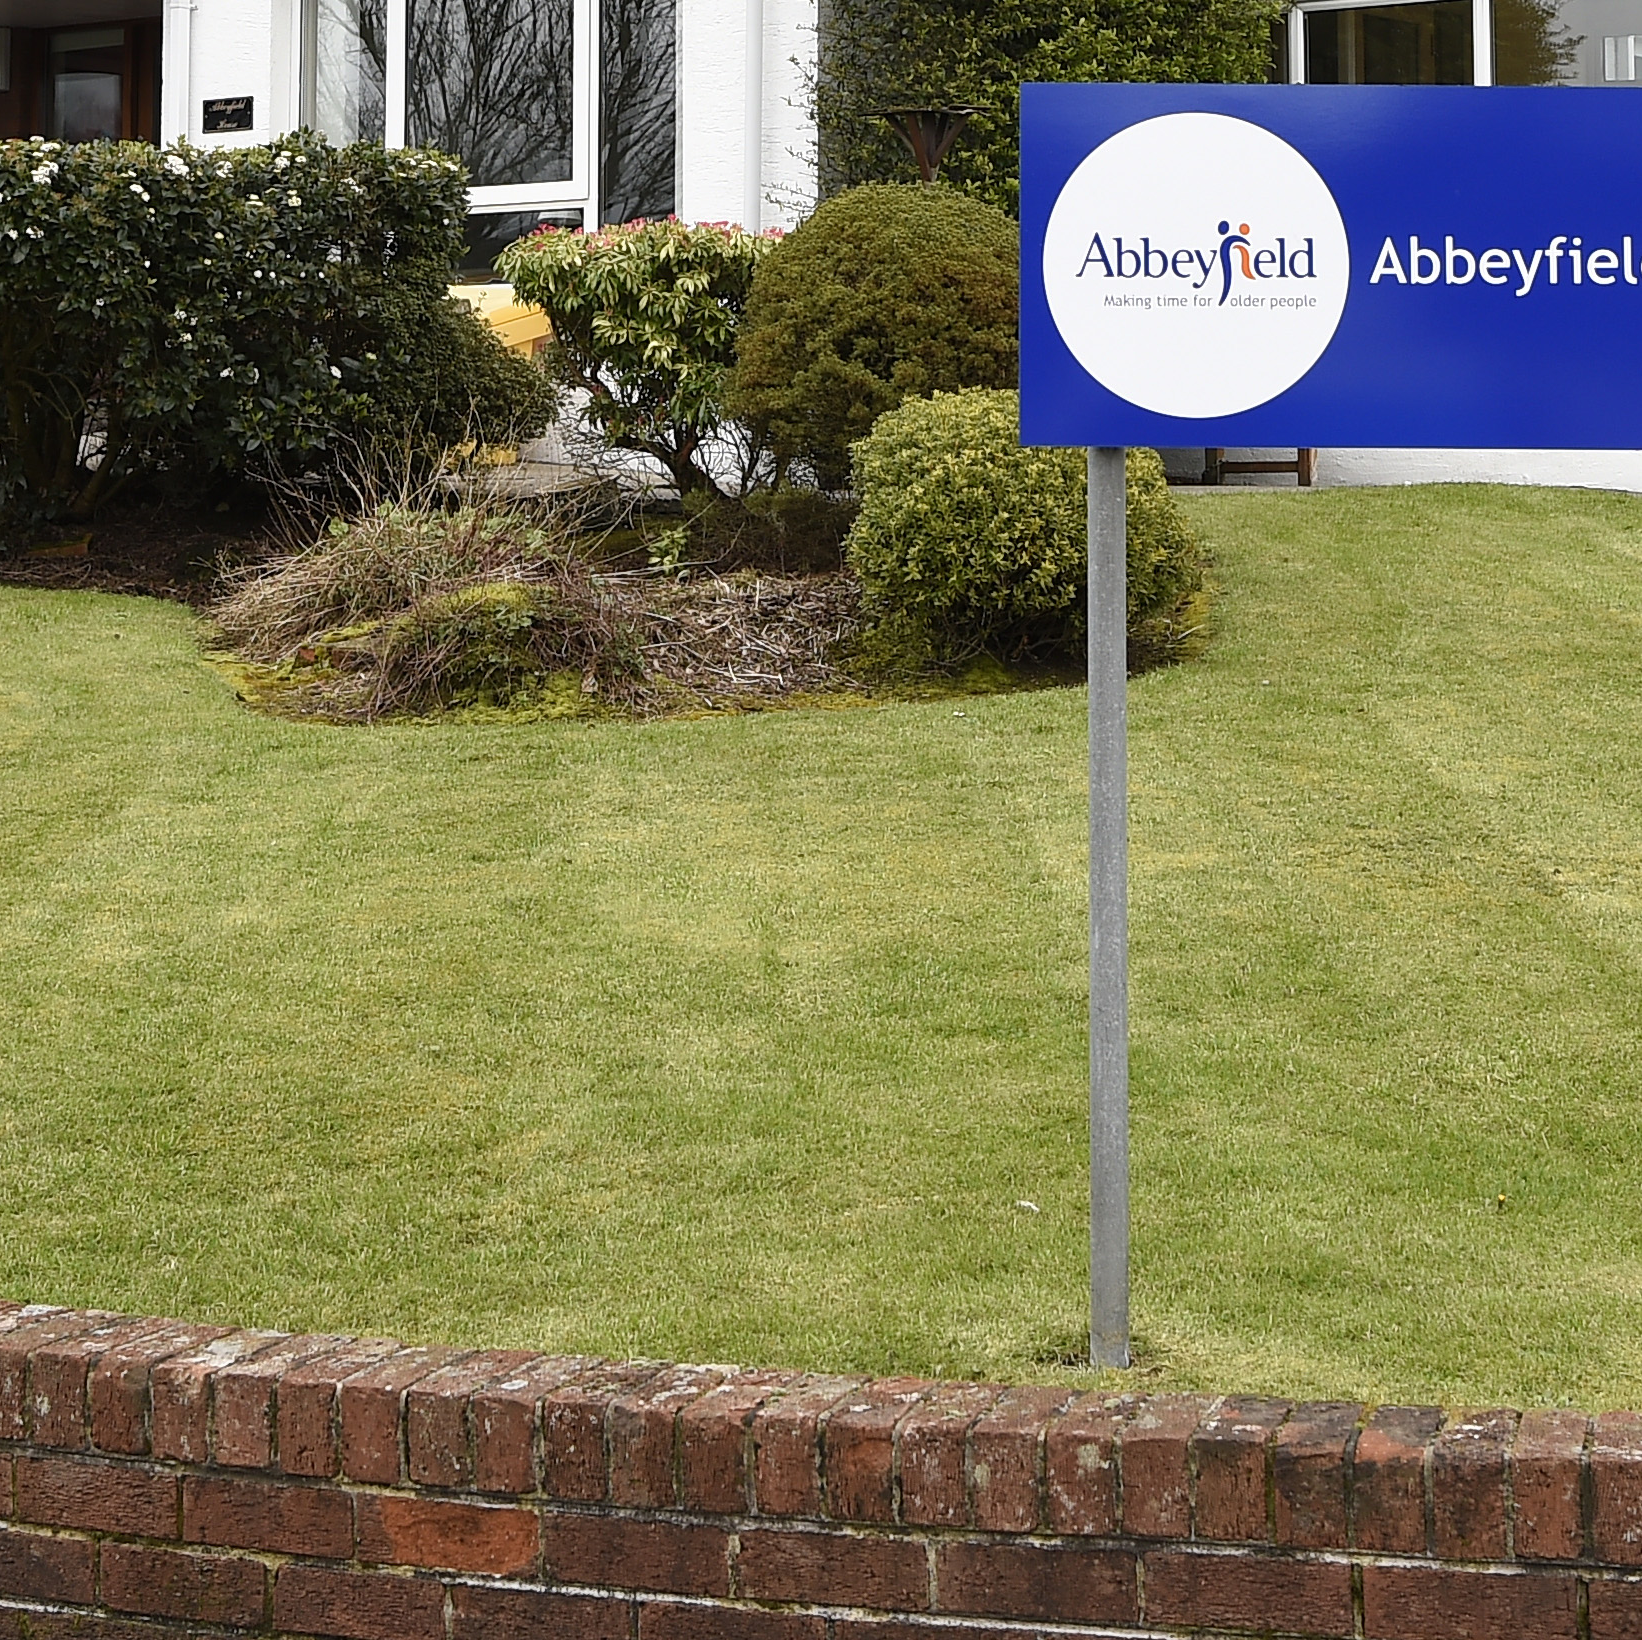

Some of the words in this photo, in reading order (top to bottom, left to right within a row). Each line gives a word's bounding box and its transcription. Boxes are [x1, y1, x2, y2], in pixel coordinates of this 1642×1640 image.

[1075, 221, 1317, 306] Abbeyfield
[1103, 294, 1152, 310] Making
[1157, 295, 1188, 307] time
[1193, 294, 1213, 307] for
[1230, 294, 1265, 307] older
[1270, 294, 1317, 310] people
